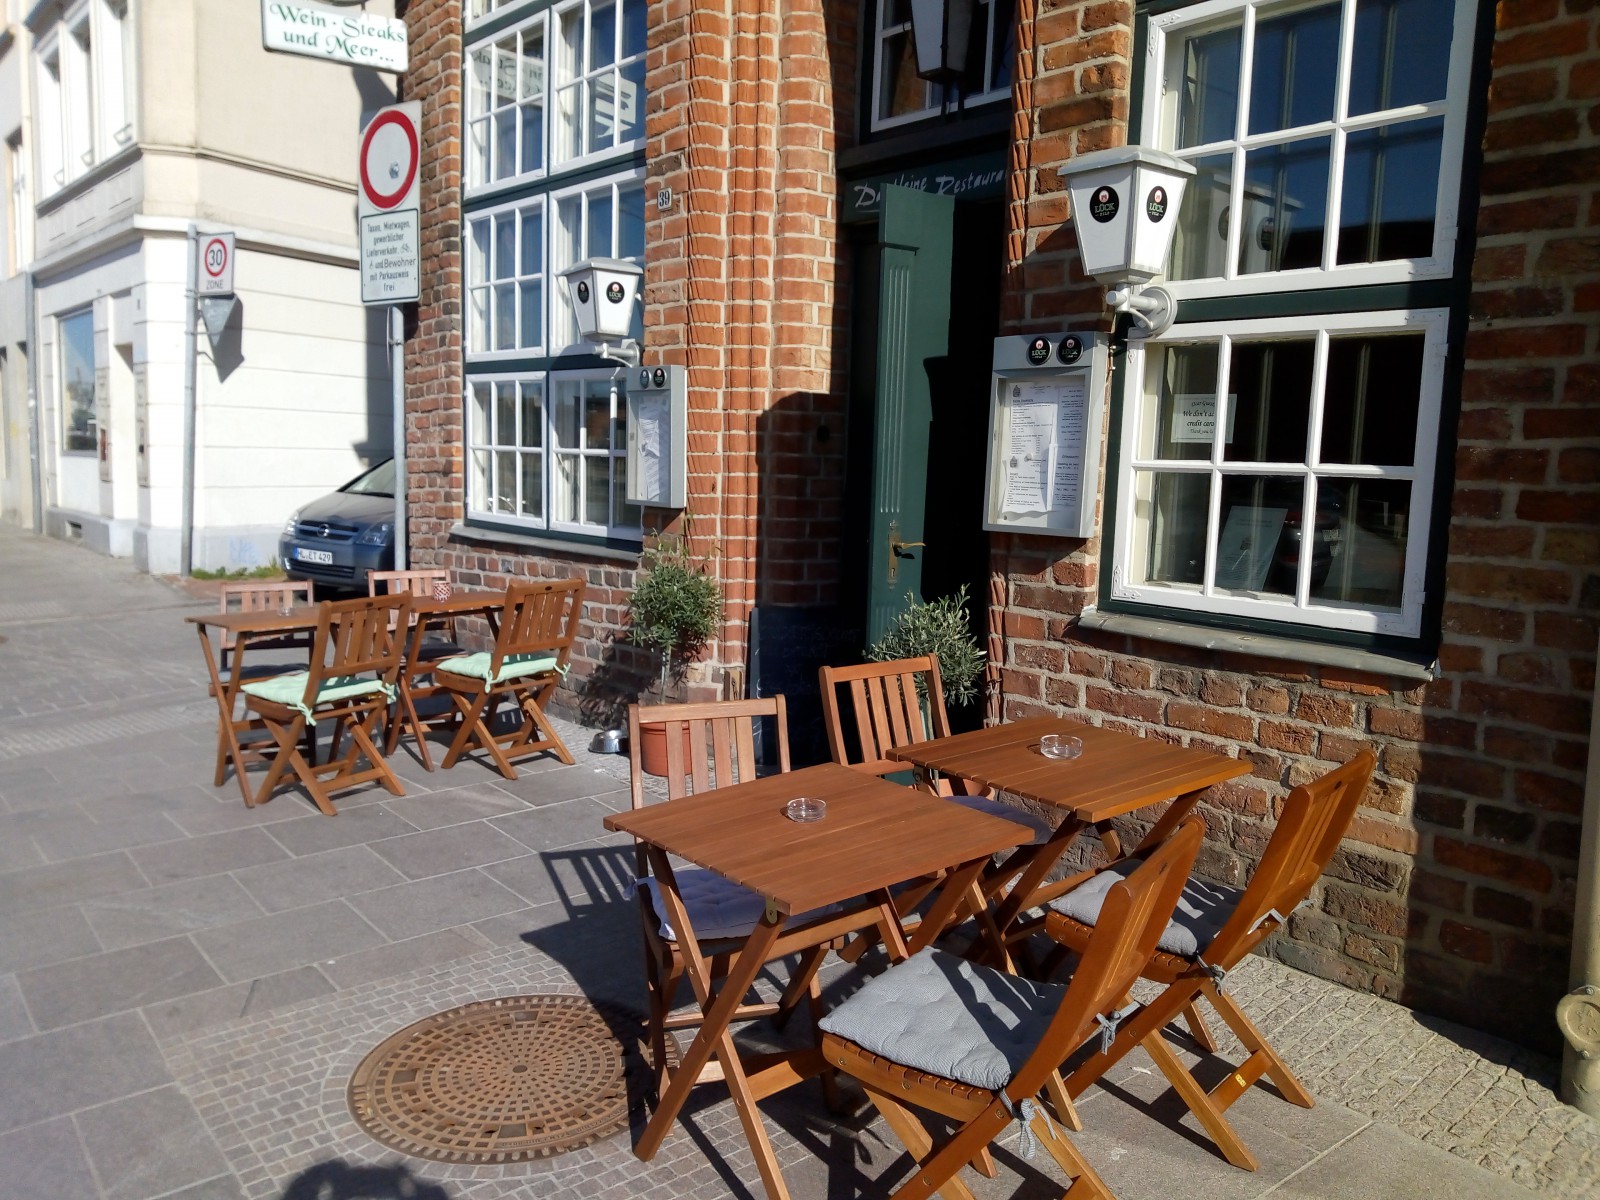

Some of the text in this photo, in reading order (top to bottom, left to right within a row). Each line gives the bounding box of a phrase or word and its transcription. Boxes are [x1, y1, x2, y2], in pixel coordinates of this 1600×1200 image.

[270, 4, 405, 43] Wein Steaks
[284, 31, 318, 47] und
[659, 190, 670, 207] 39
[209, 249, 223, 266] 30
[384, 258, 416, 269] Bewohner
[207, 279, 224, 290] ZONE
[383, 283, 395, 292] frei
